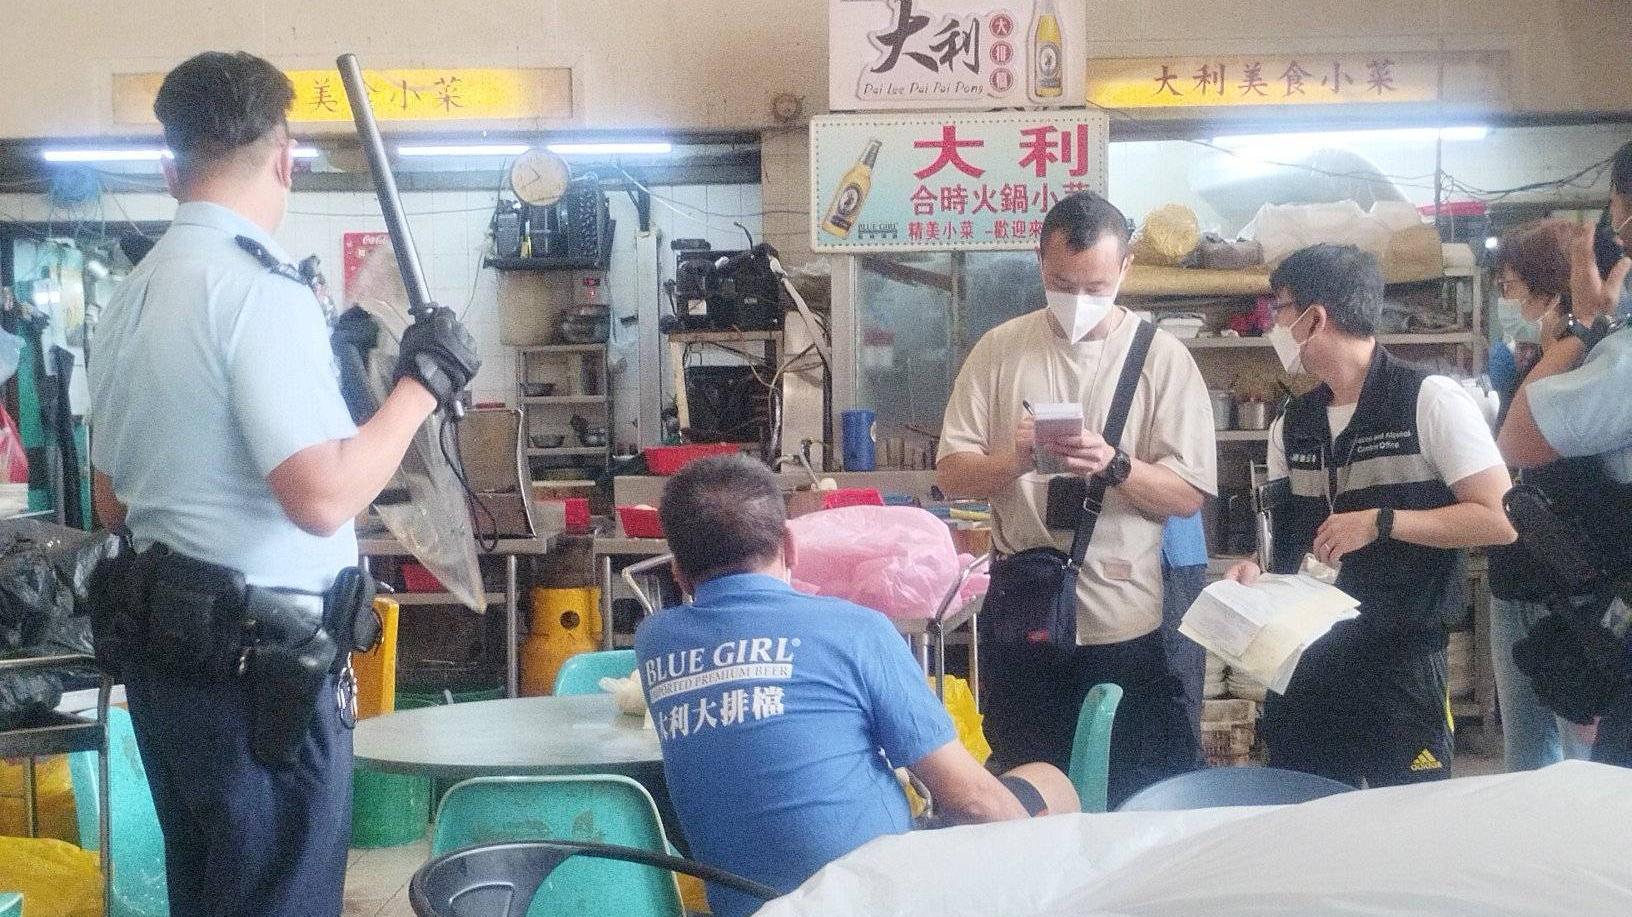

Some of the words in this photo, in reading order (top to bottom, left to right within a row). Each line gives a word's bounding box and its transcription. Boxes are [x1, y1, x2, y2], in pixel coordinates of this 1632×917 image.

[870, 0, 980, 74] 大利
[307, 76, 464, 112] 美小菜
[1153, 59, 1399, 97] 大利美食小菜
[913, 124, 1089, 180] 大利
[645, 648, 705, 687] BLUE
[713, 637, 795, 668] GIRL
[753, 665, 789, 677] BEER
